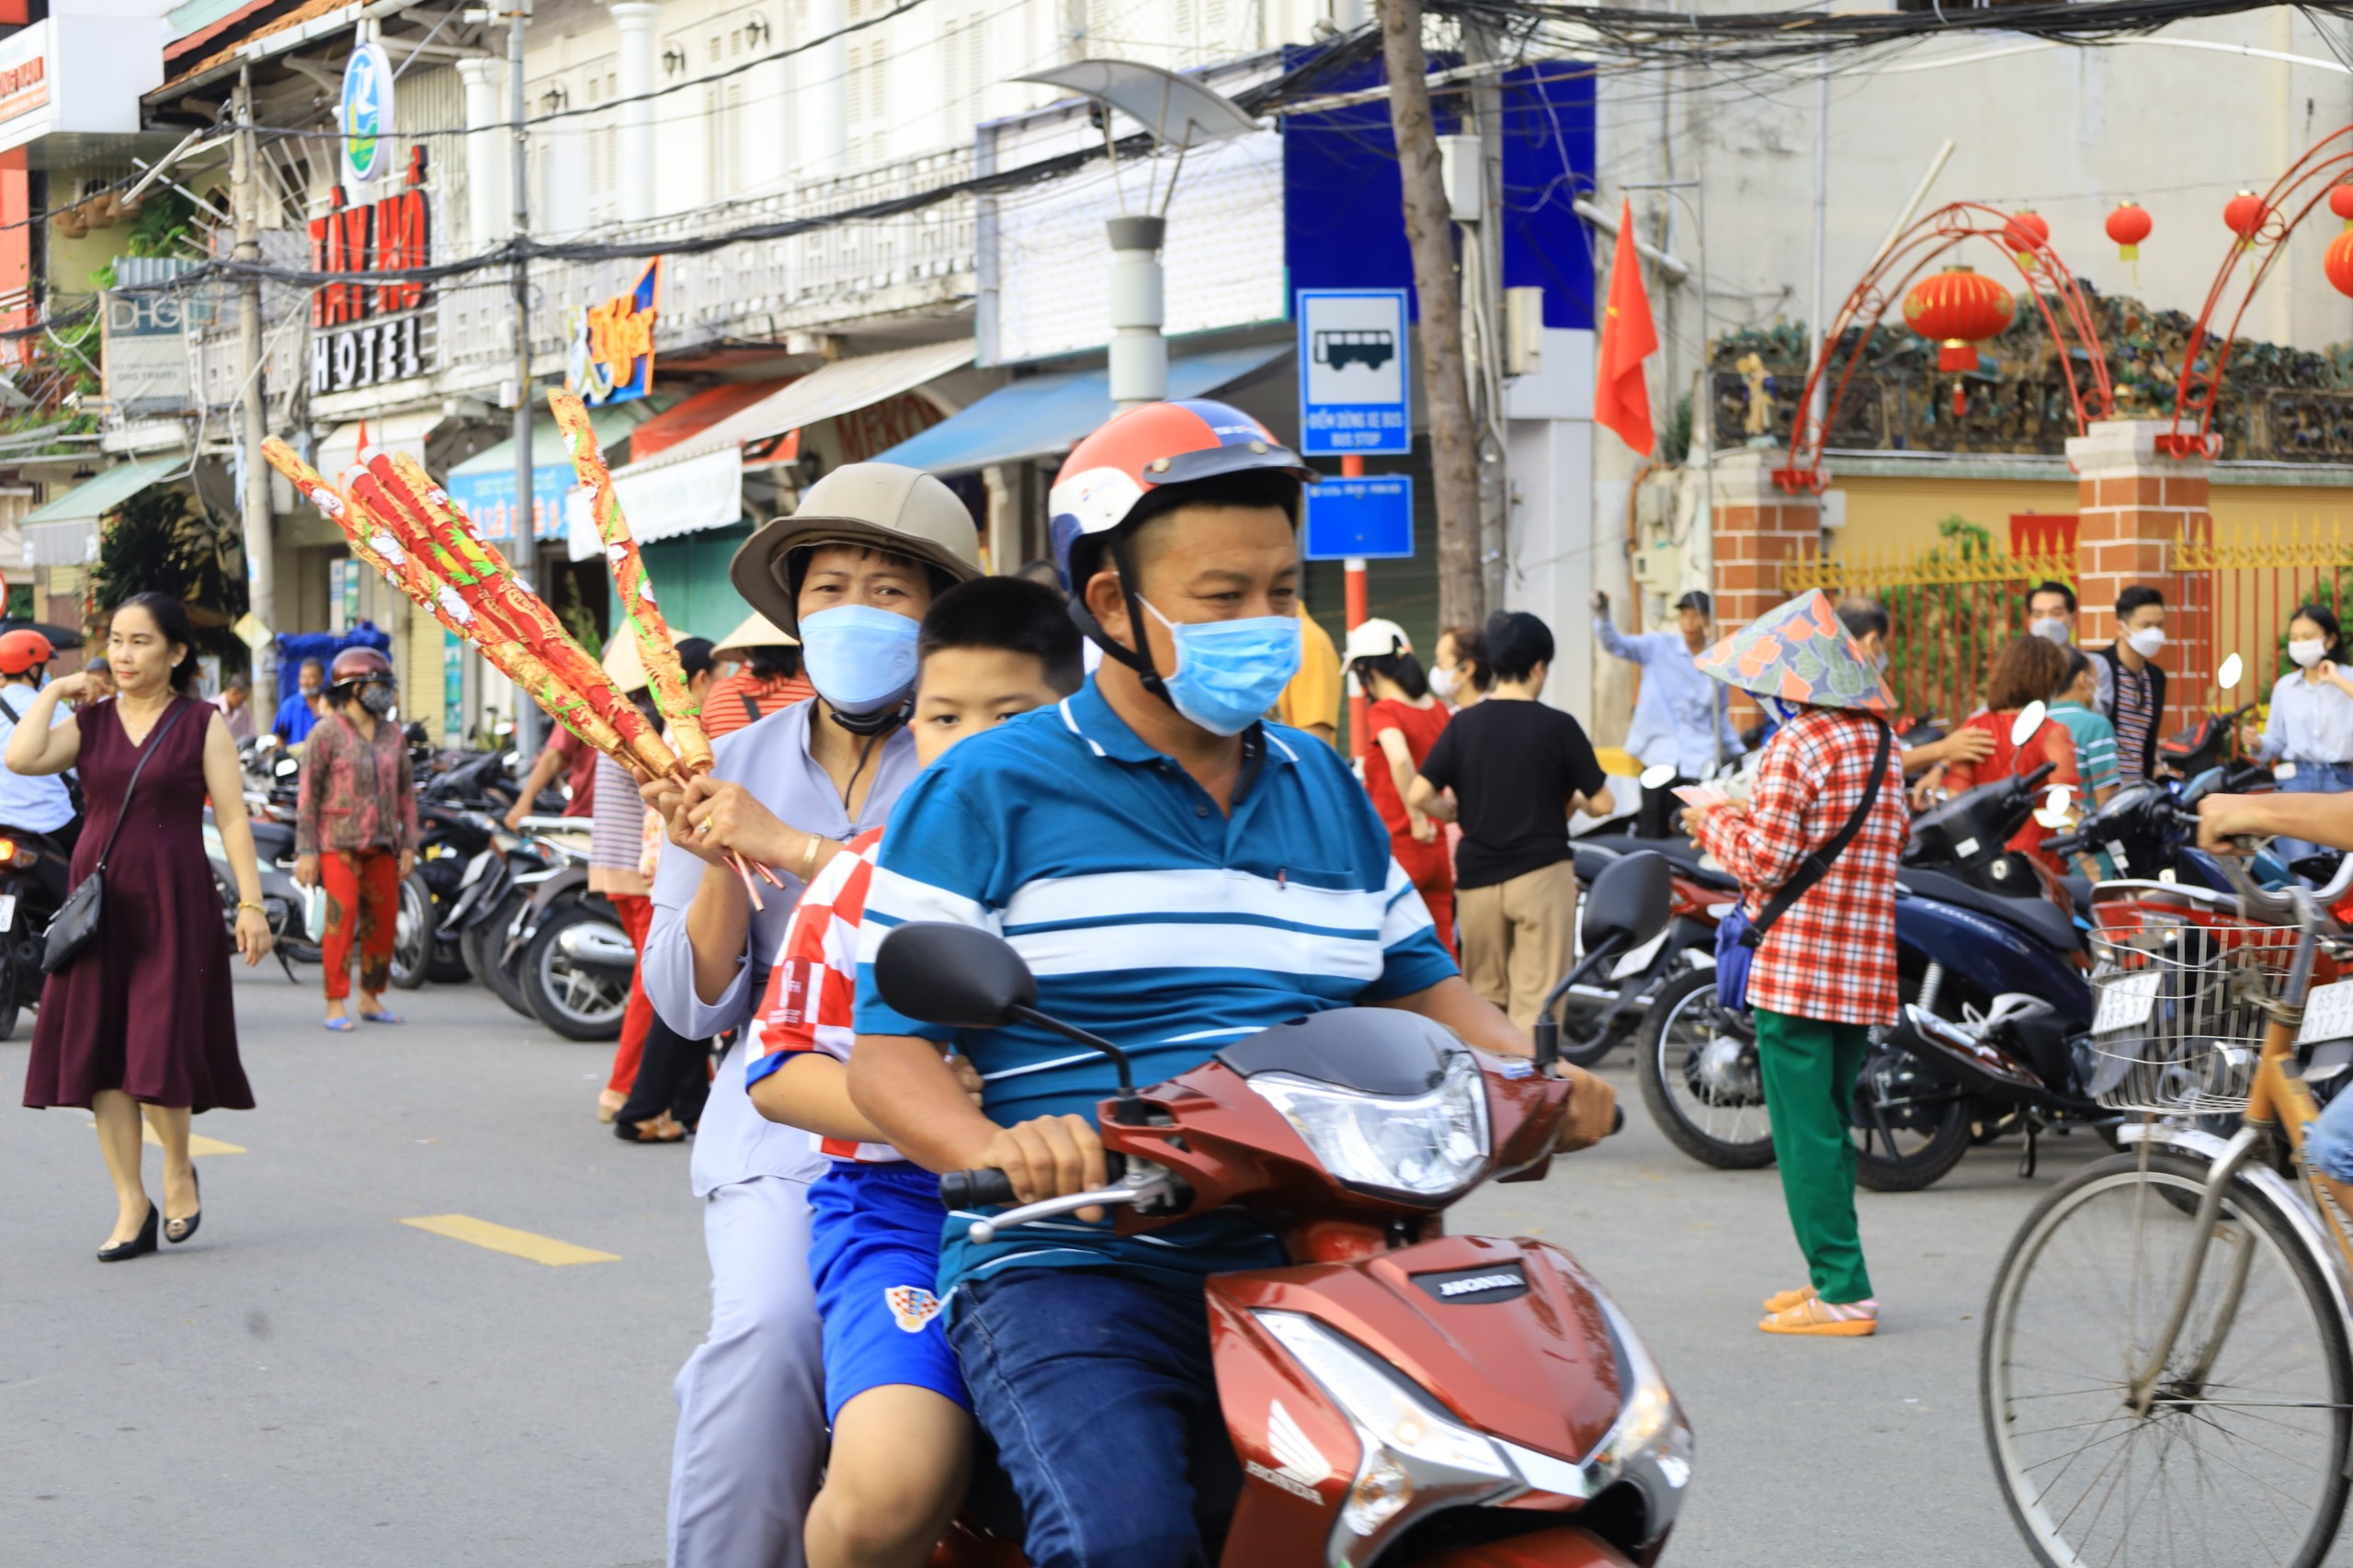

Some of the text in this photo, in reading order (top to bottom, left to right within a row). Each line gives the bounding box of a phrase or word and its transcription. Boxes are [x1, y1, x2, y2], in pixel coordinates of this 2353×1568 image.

[111, 298, 181, 330] DHG
[311, 317, 420, 396] HOTEL
[1331, 431, 1381, 448] BUS STOP
[1438, 1274, 1525, 1297] HONDA
[1245, 1459, 1325, 1506] HONDA
